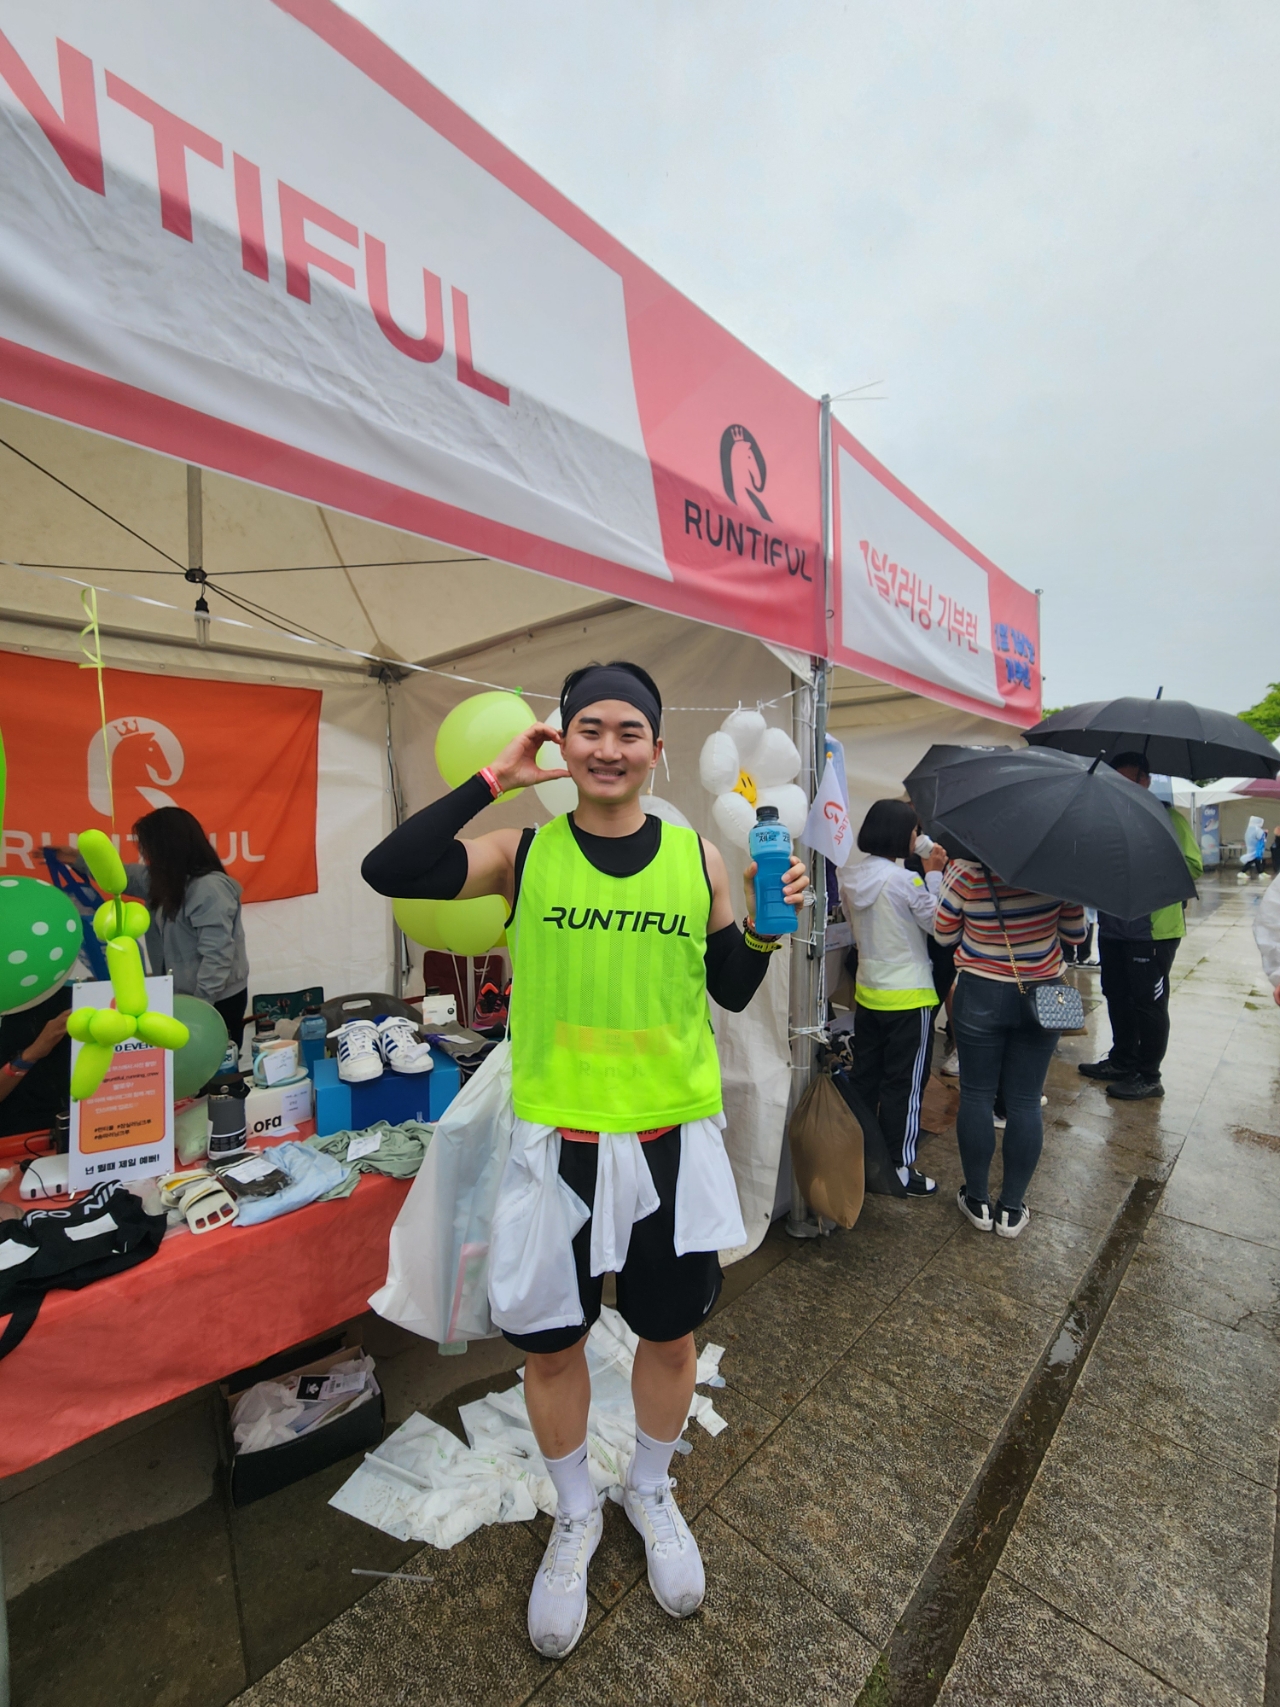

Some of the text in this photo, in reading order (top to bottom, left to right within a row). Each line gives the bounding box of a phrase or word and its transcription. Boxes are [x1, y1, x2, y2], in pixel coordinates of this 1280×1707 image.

[684, 498, 812, 582] RUNTIFUL
[859, 540, 932, 631] 1일1러닝
[937, 594, 979, 654] 기부런
[543, 906, 691, 938] RUNTIFUL
